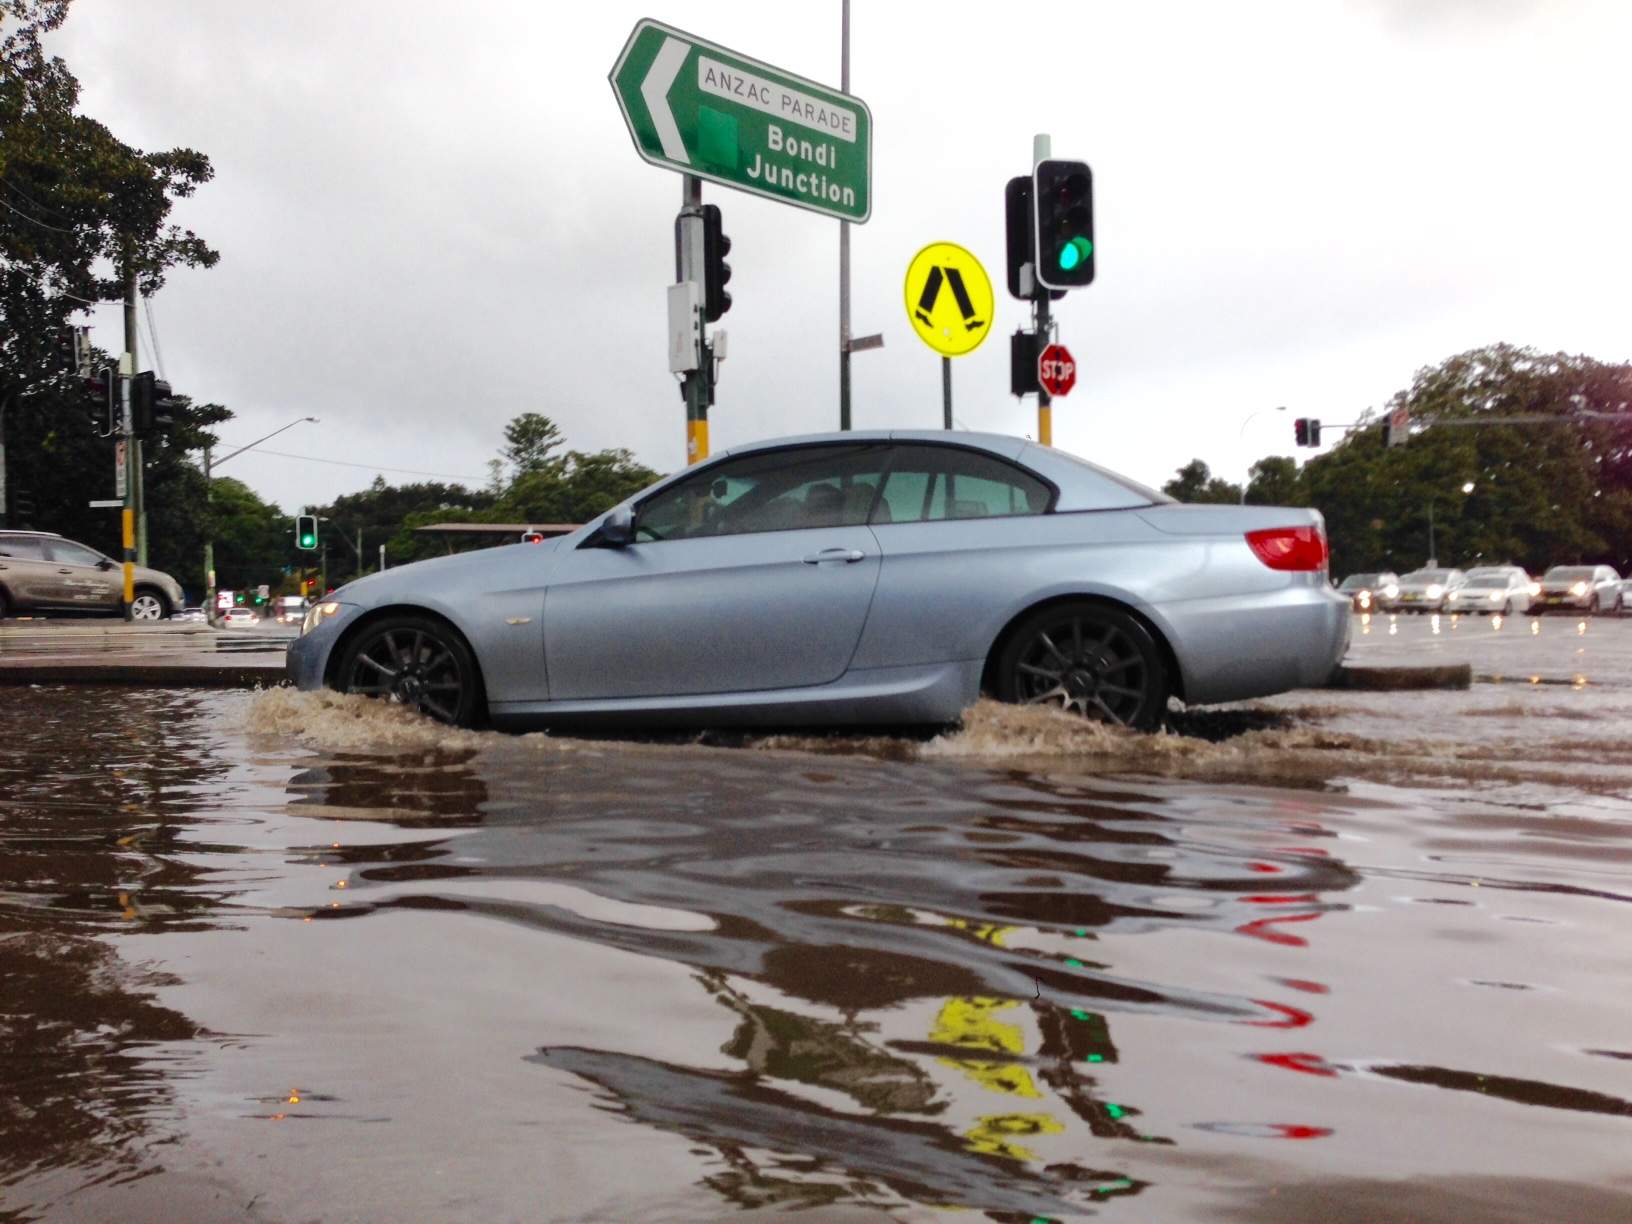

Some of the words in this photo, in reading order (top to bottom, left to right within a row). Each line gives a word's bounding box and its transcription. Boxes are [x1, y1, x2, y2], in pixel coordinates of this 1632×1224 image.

[705, 68, 770, 105] ANZAC
[782, 95, 851, 134] PARADE
[768, 124, 835, 169] Bondi
[747, 154, 855, 207] Junction
[1042, 360, 1073, 380] STOP
